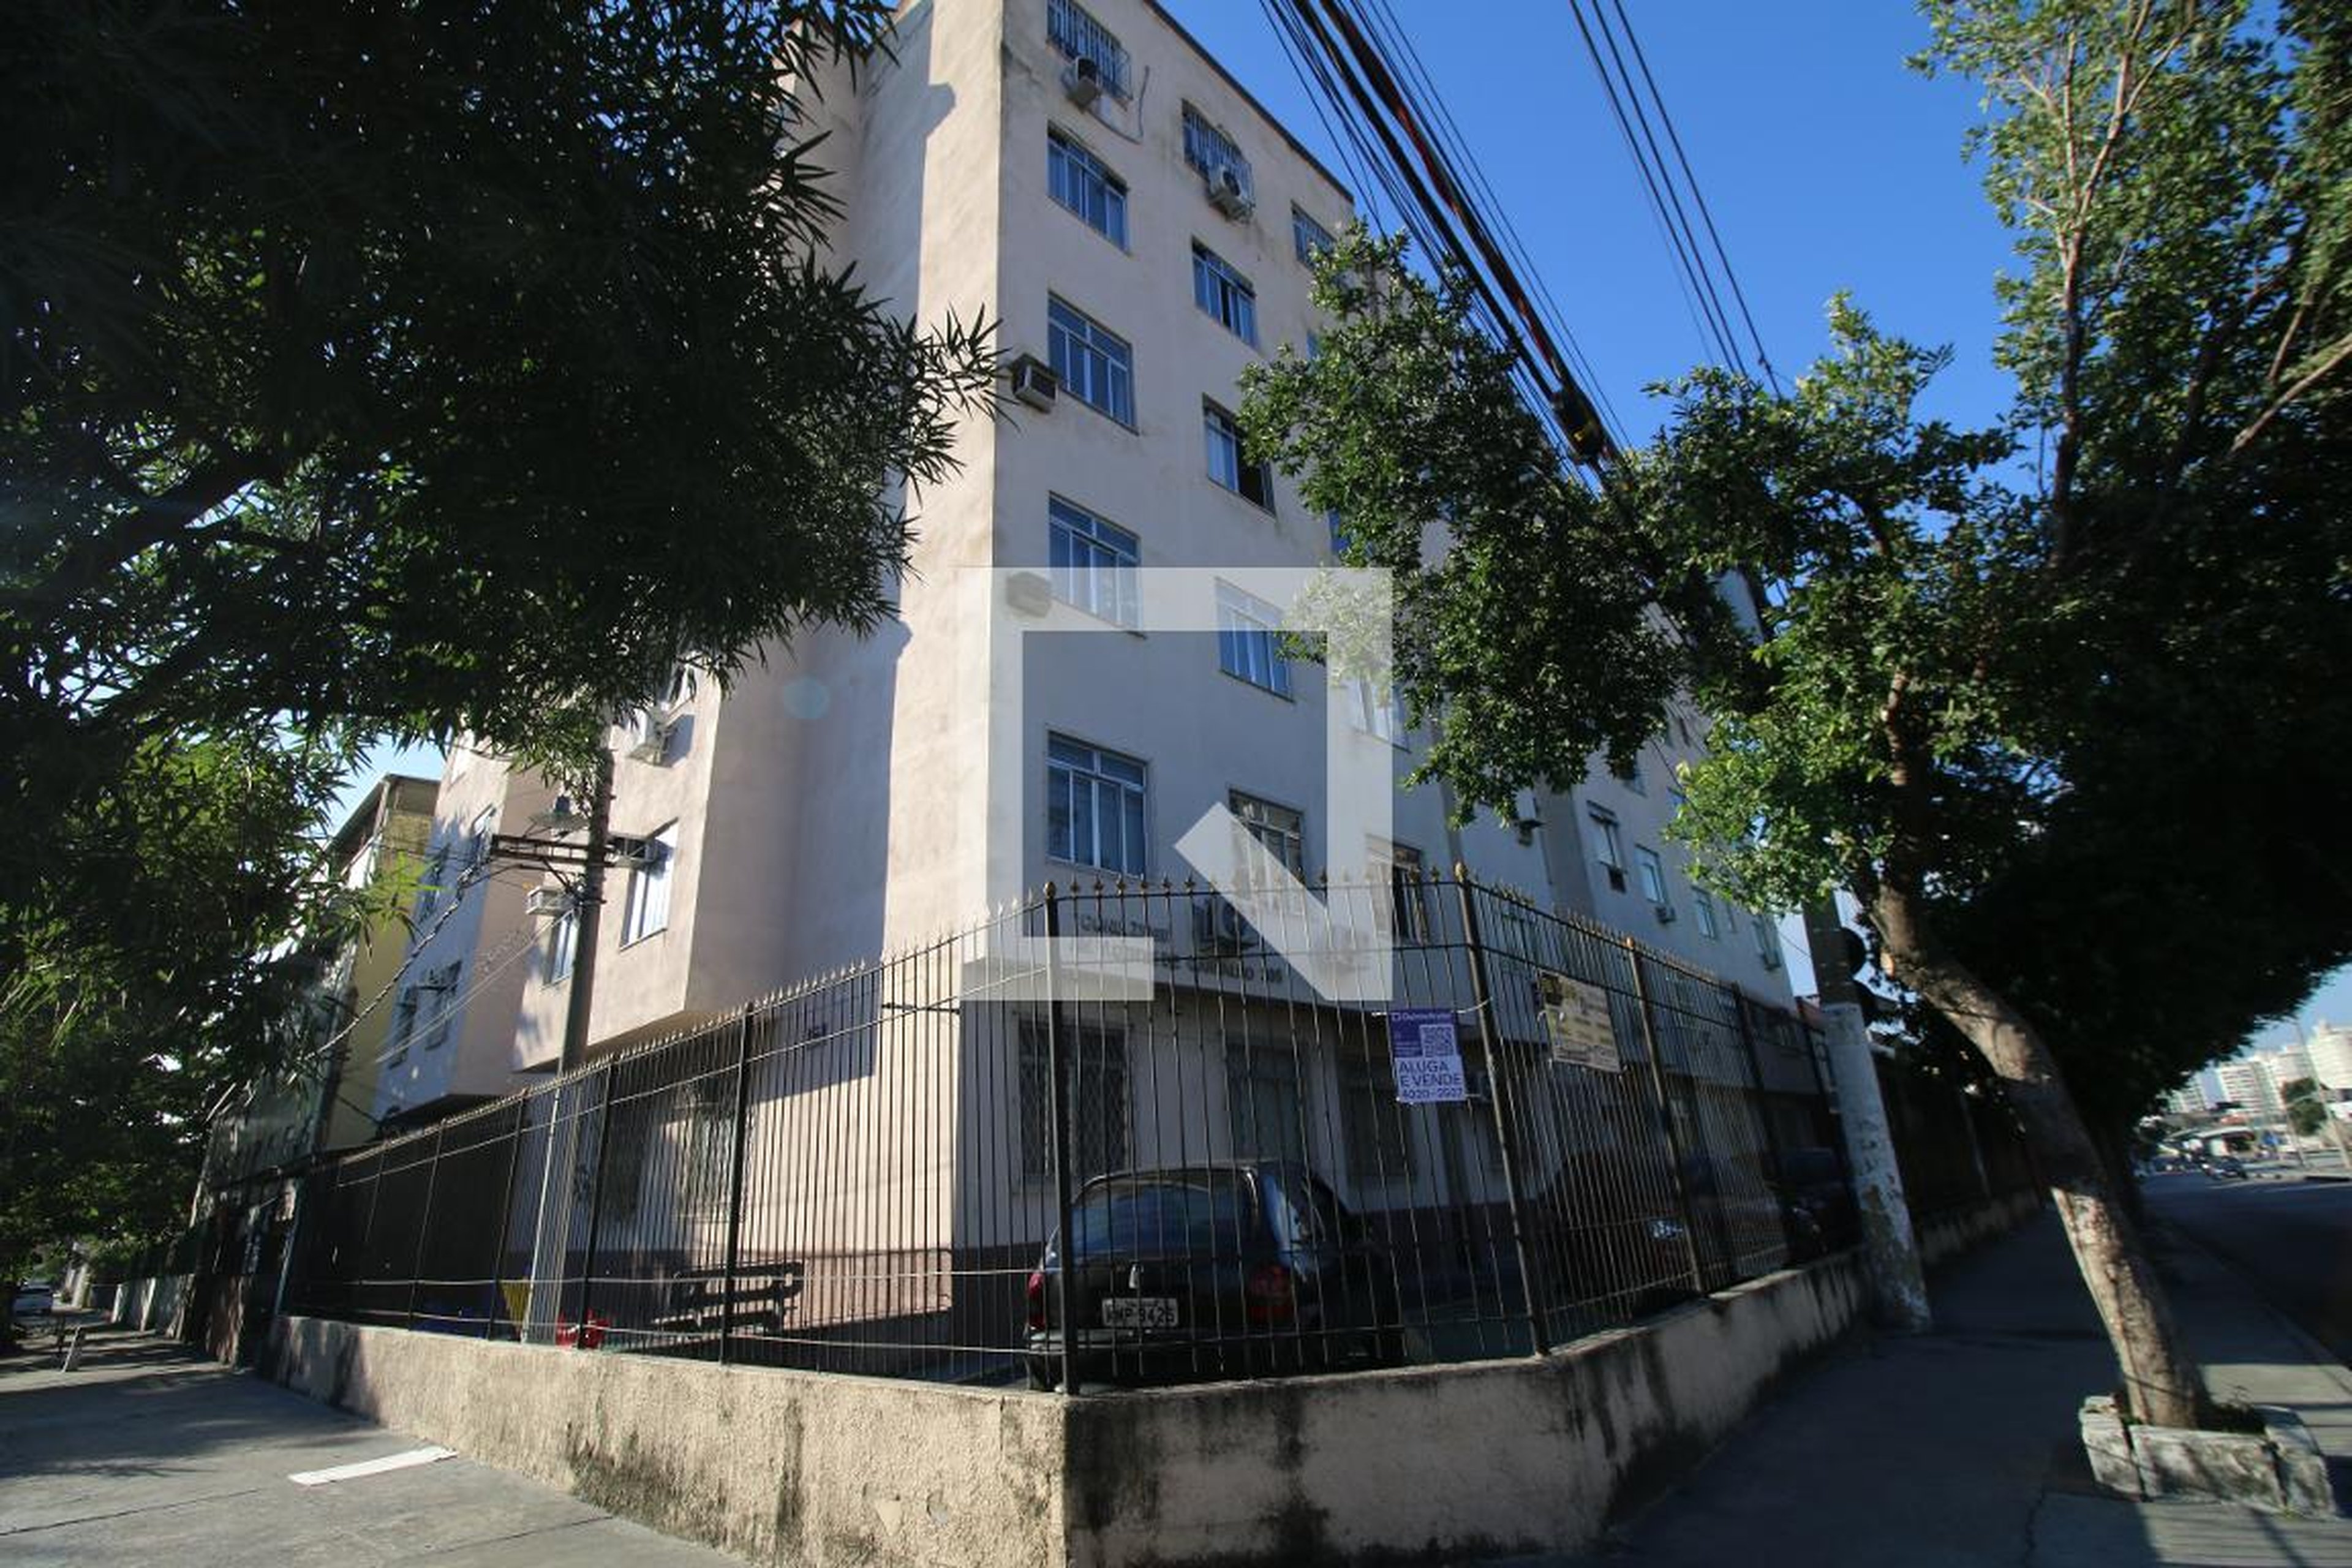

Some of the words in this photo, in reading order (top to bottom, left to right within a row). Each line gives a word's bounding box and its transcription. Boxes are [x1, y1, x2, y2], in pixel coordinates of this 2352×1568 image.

[1399, 1060, 1449, 1074] ALUGA
[1400, 1075, 1410, 1087] E
[1412, 1073, 1462, 1087] VENDE
